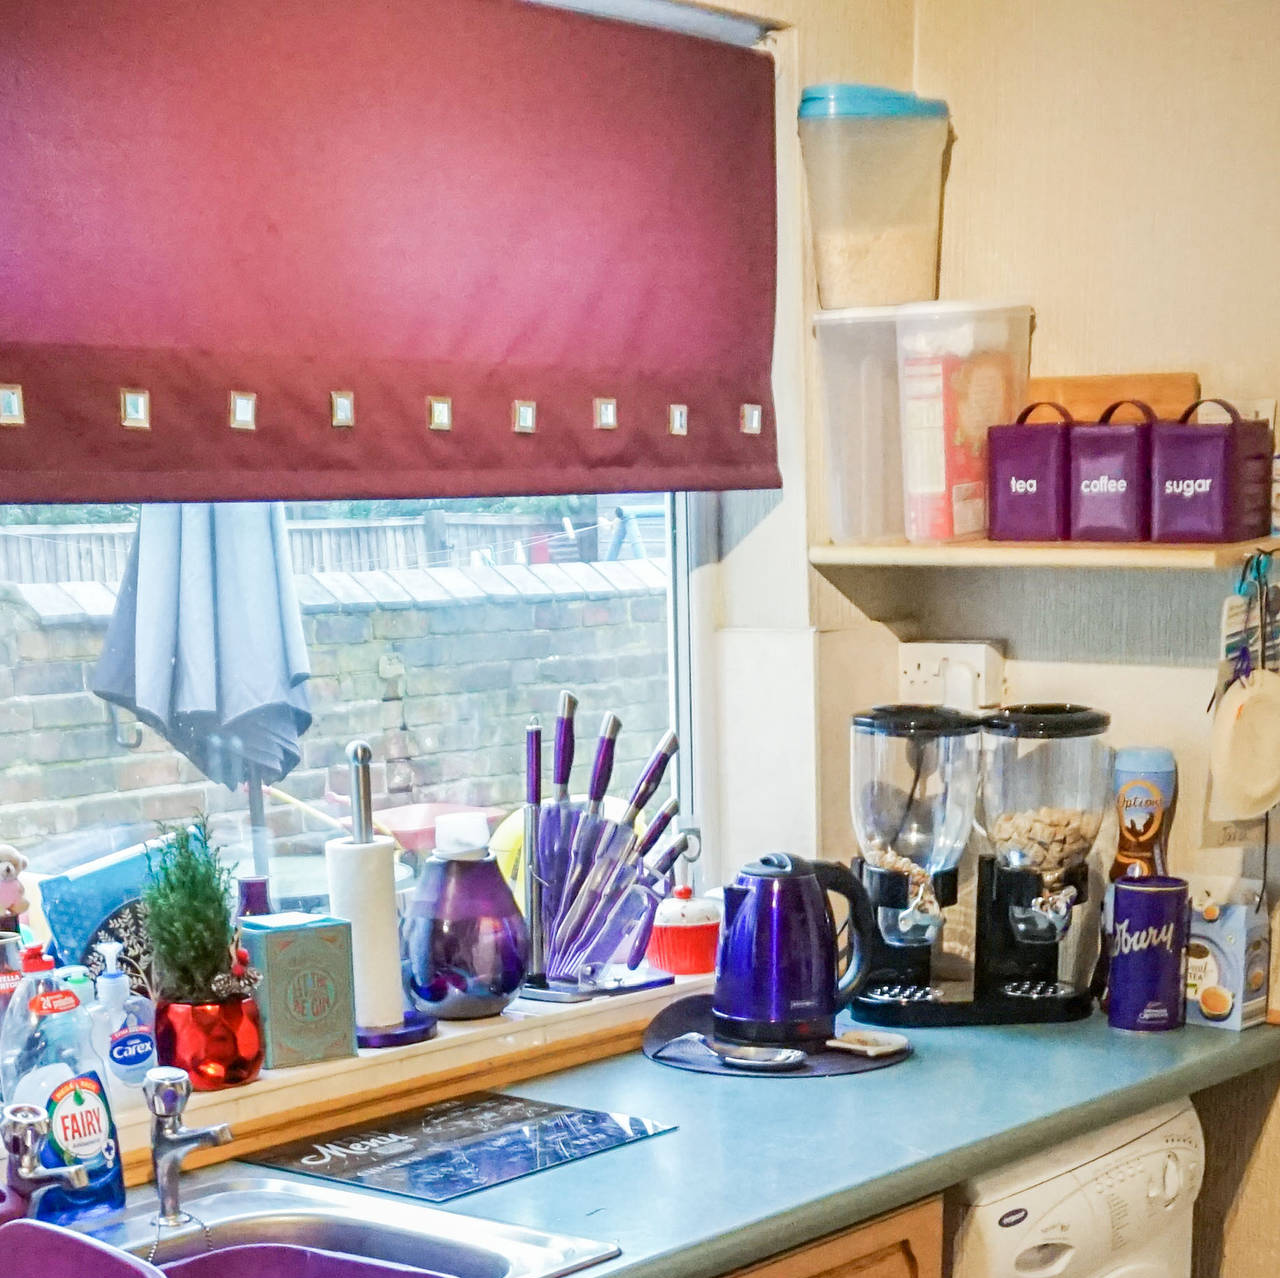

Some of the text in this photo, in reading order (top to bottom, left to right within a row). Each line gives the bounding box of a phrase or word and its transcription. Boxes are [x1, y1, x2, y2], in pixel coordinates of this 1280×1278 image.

[1010, 476, 1037, 493] tea
[1080, 475, 1127, 493] coffee
[1165, 478, 1213, 497] sugar
[112, 1041, 153, 1059] Carex
[61, 1107, 102, 1142] FAIRY
[301, 1133, 409, 1165] Menu
